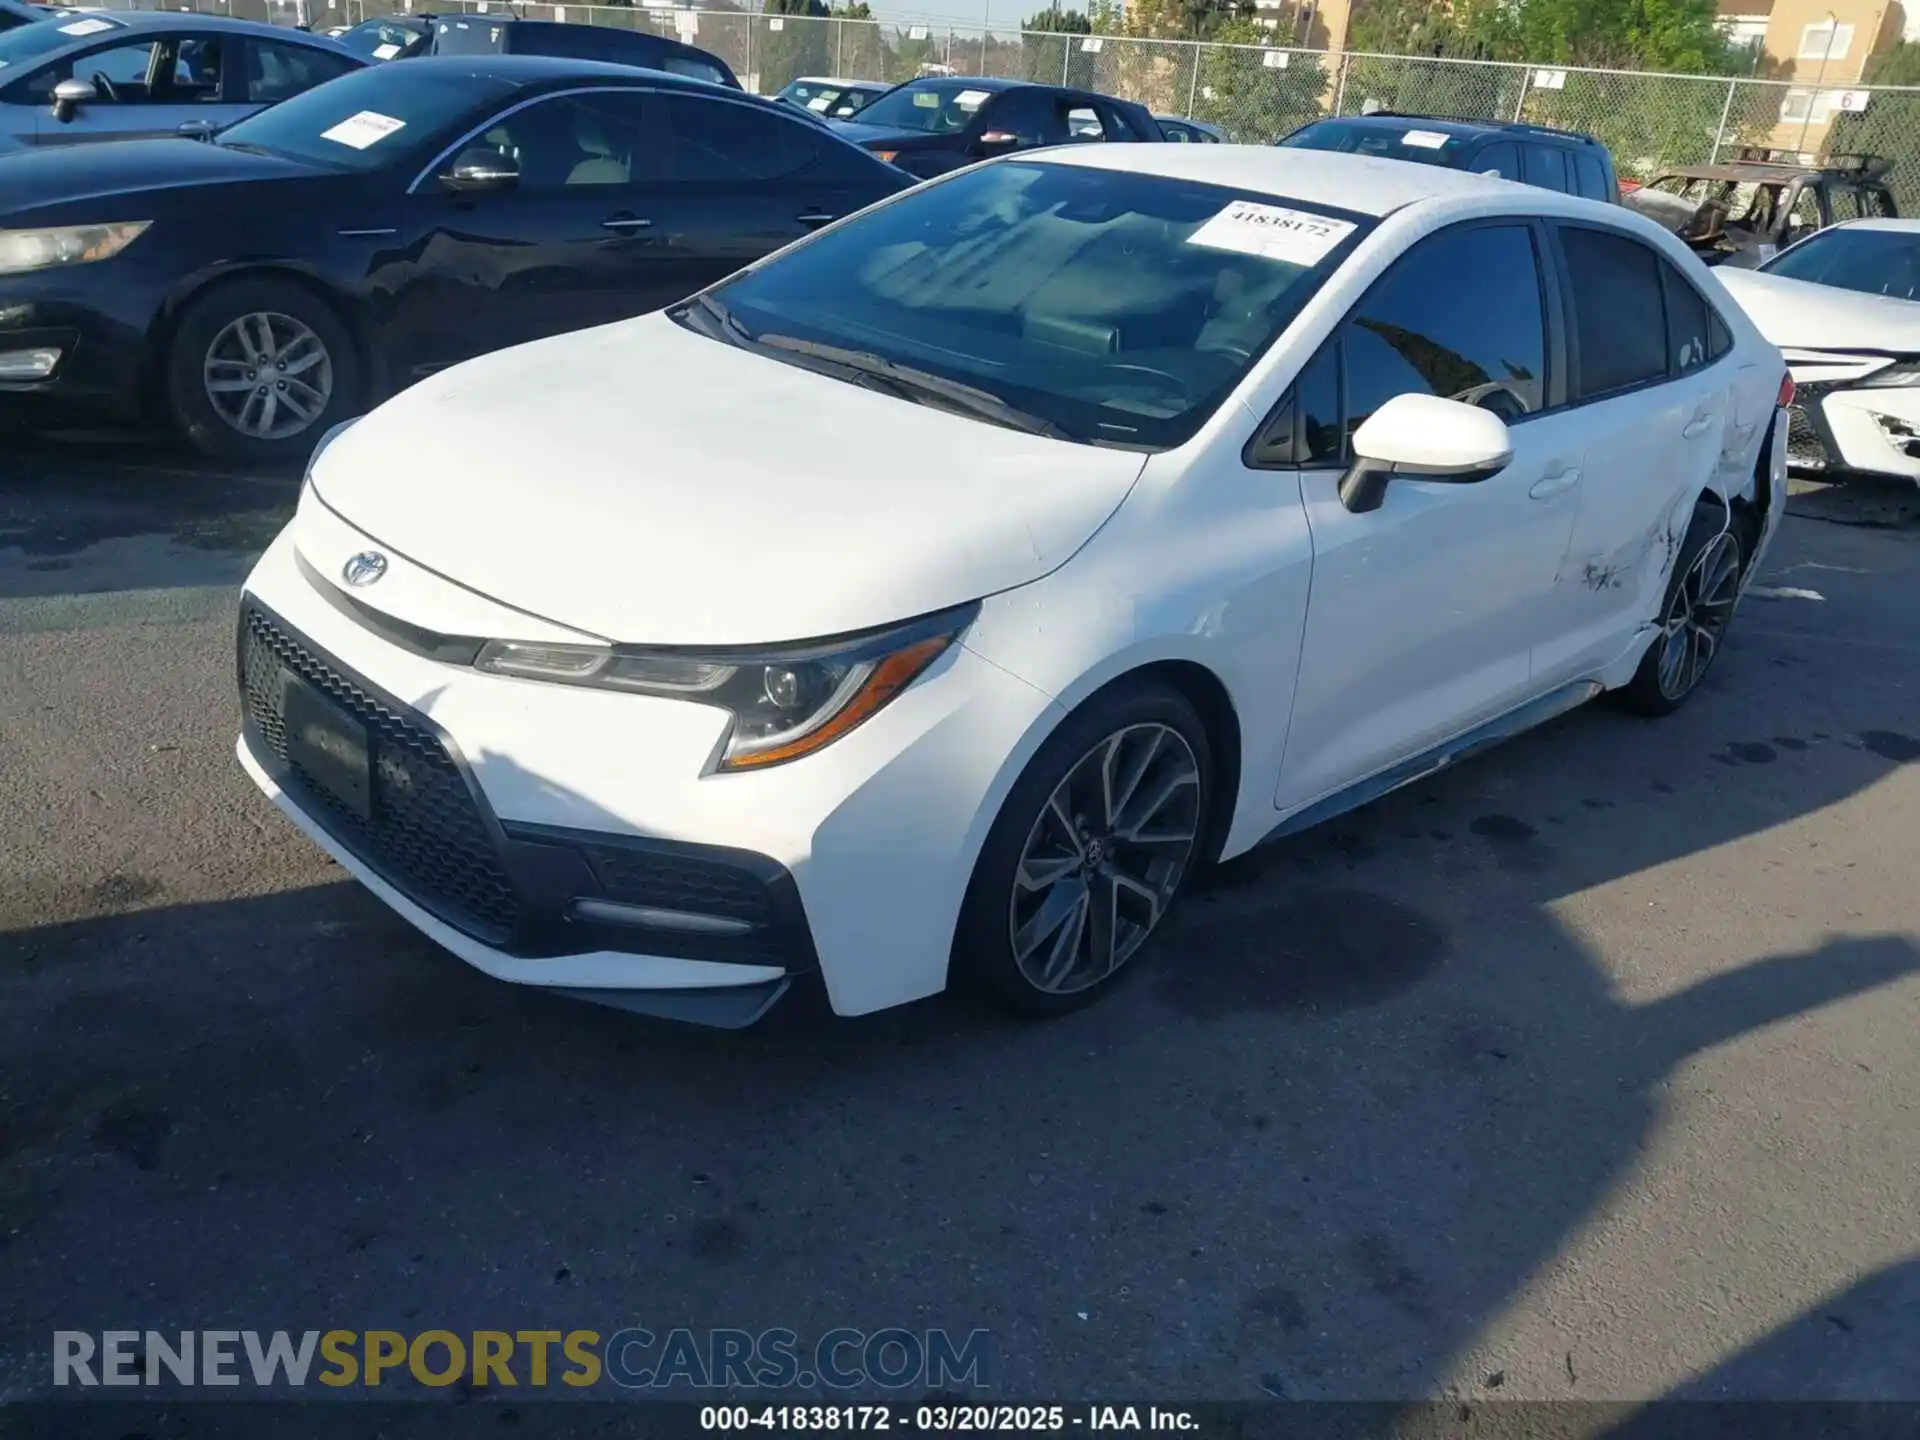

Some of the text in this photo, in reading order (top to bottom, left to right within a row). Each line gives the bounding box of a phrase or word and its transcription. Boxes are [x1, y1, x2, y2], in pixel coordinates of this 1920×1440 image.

[1546, 71, 1556, 87] 7
[1841, 92, 1853, 108] 6
[1232, 211, 1330, 238] 41838172
